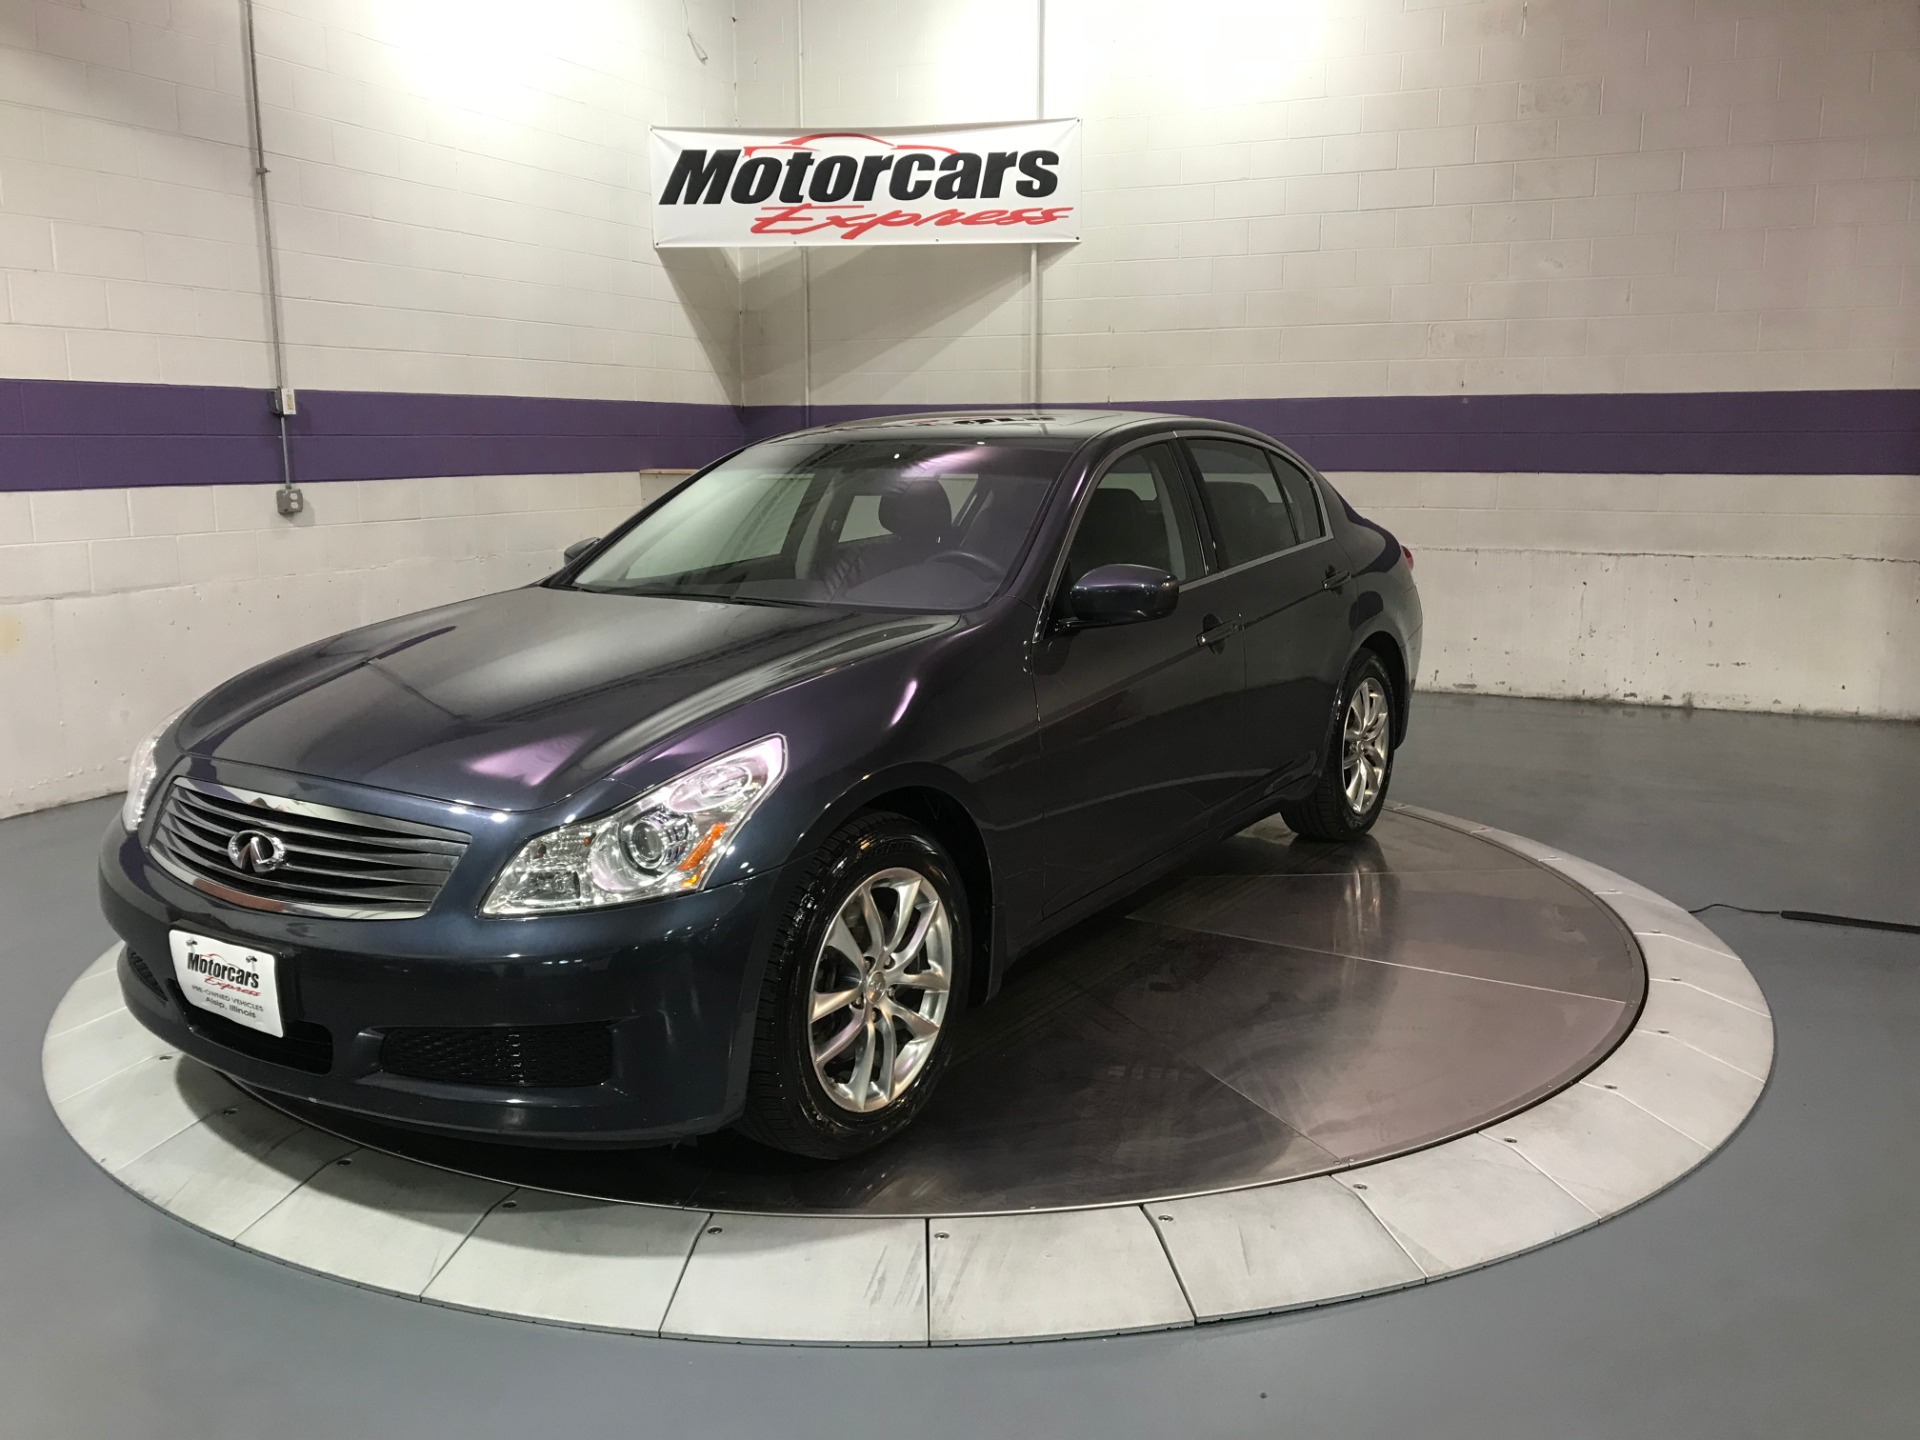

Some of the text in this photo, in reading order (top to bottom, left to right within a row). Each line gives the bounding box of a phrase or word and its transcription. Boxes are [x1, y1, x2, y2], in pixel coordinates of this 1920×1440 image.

[658, 148, 1060, 205] Motorcars
[750, 203, 1074, 240] Express
[187, 952, 259, 988] Motorcars
[204, 975, 261, 997] Express
[205, 996, 257, 1019] Alsip, Illinois
[231, 997, 264, 1012] VEHICLES
